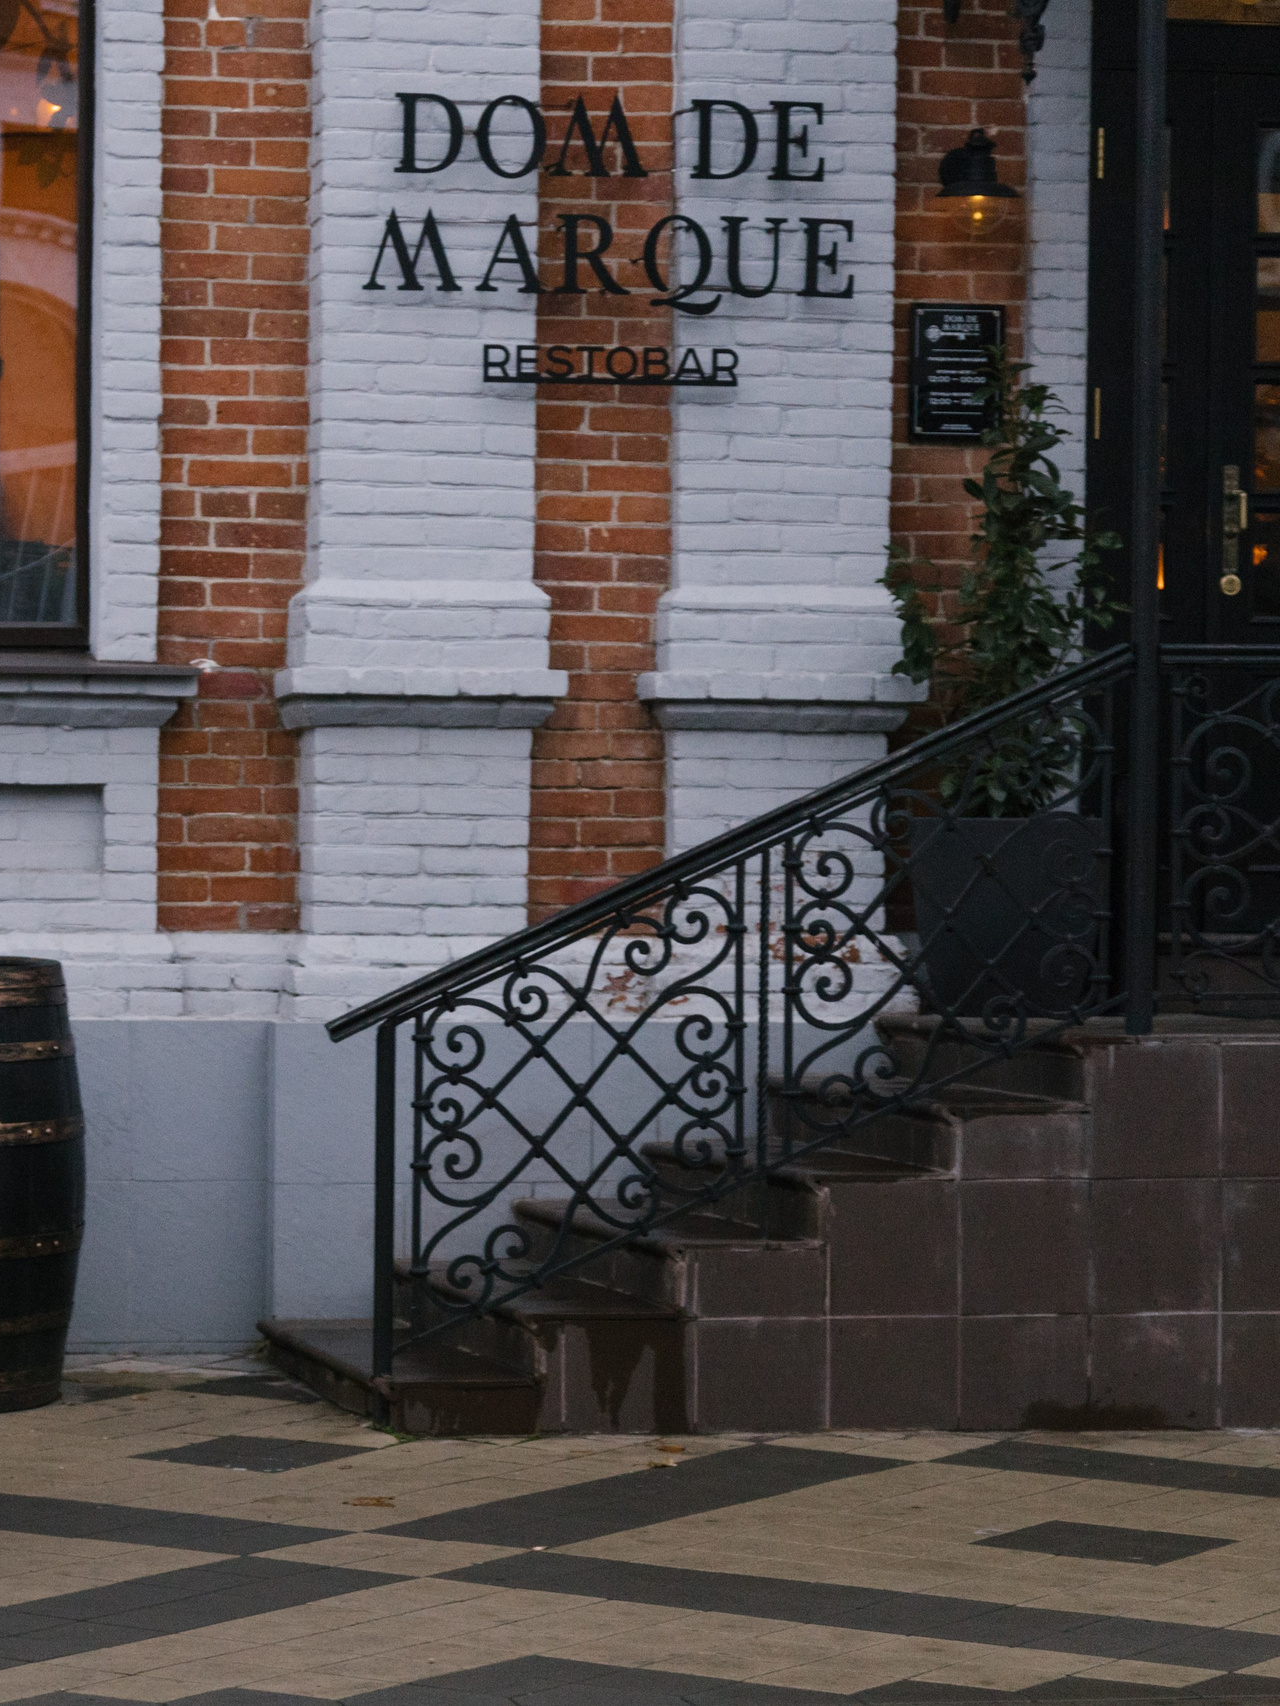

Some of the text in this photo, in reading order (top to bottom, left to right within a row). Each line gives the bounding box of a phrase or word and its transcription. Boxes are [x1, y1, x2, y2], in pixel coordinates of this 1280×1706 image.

[394, 92, 824, 182] DOM DE
[362, 208, 854, 315] MARQUE
[483, 344, 739, 385] RESTOBAR
